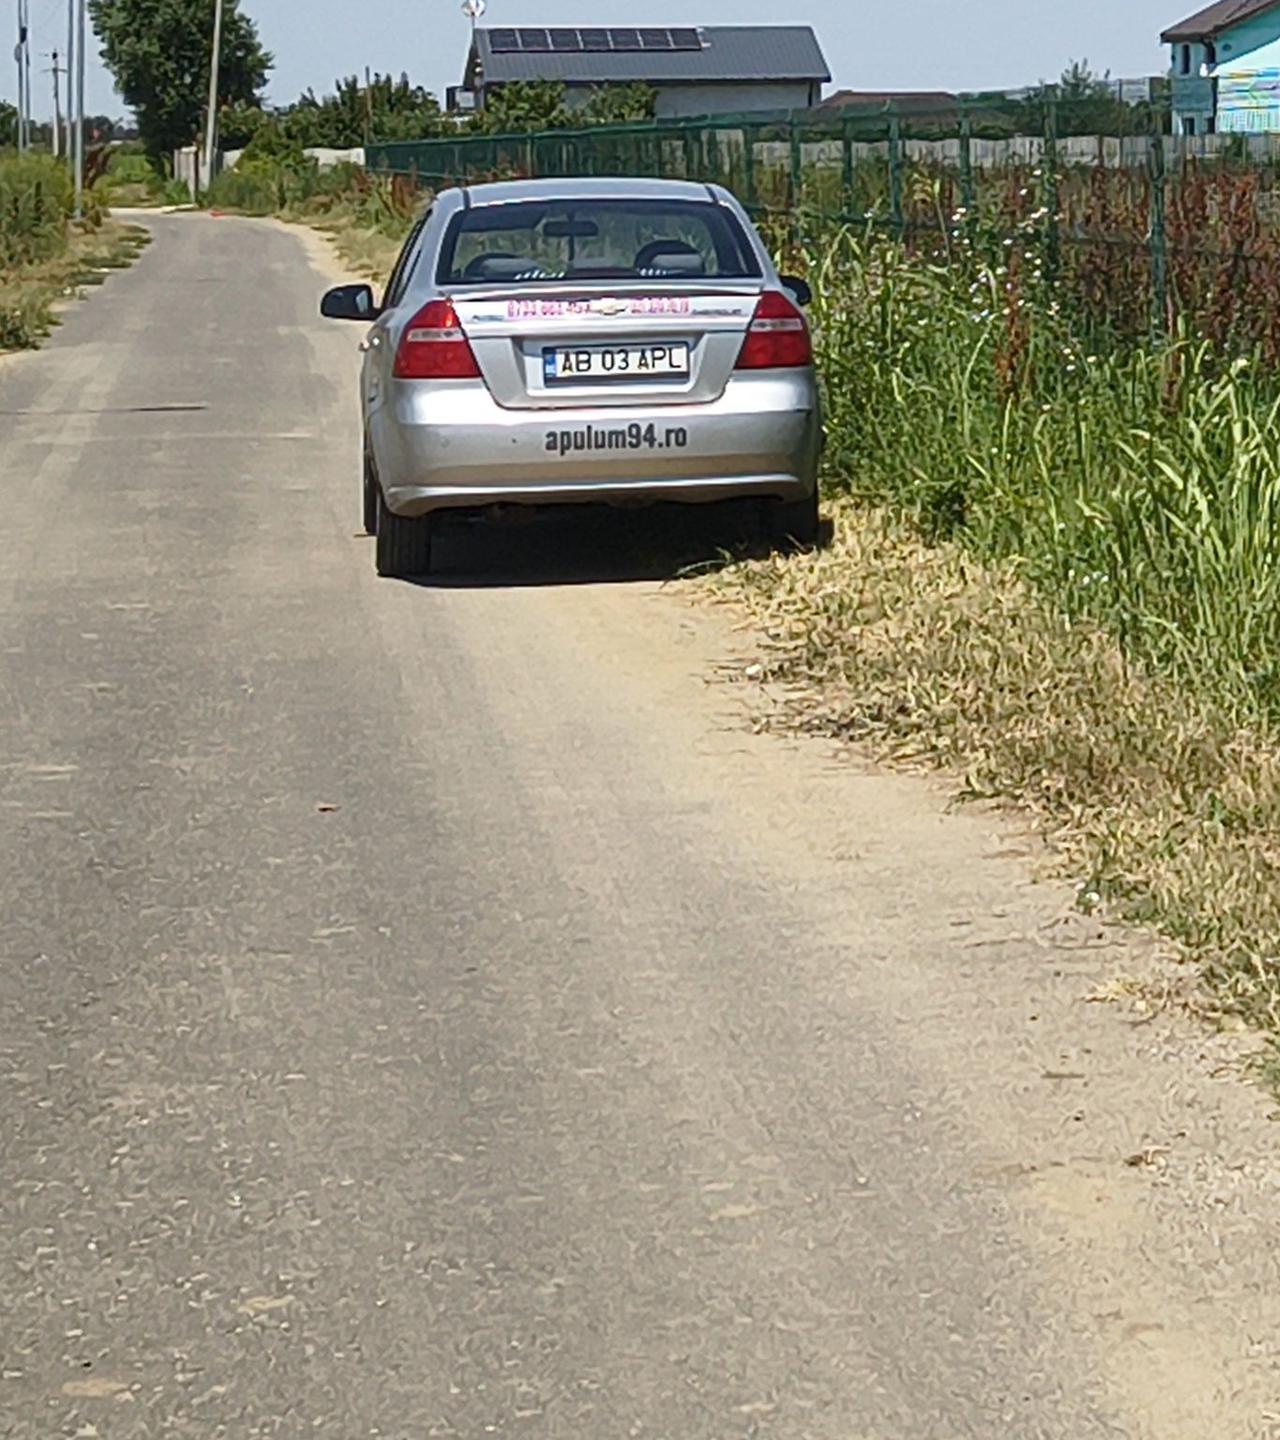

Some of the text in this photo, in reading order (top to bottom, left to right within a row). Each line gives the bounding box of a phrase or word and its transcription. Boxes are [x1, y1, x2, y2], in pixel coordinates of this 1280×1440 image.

[561, 346, 682, 372] AB 03 APL
[545, 423, 687, 456] apulum94.ro
